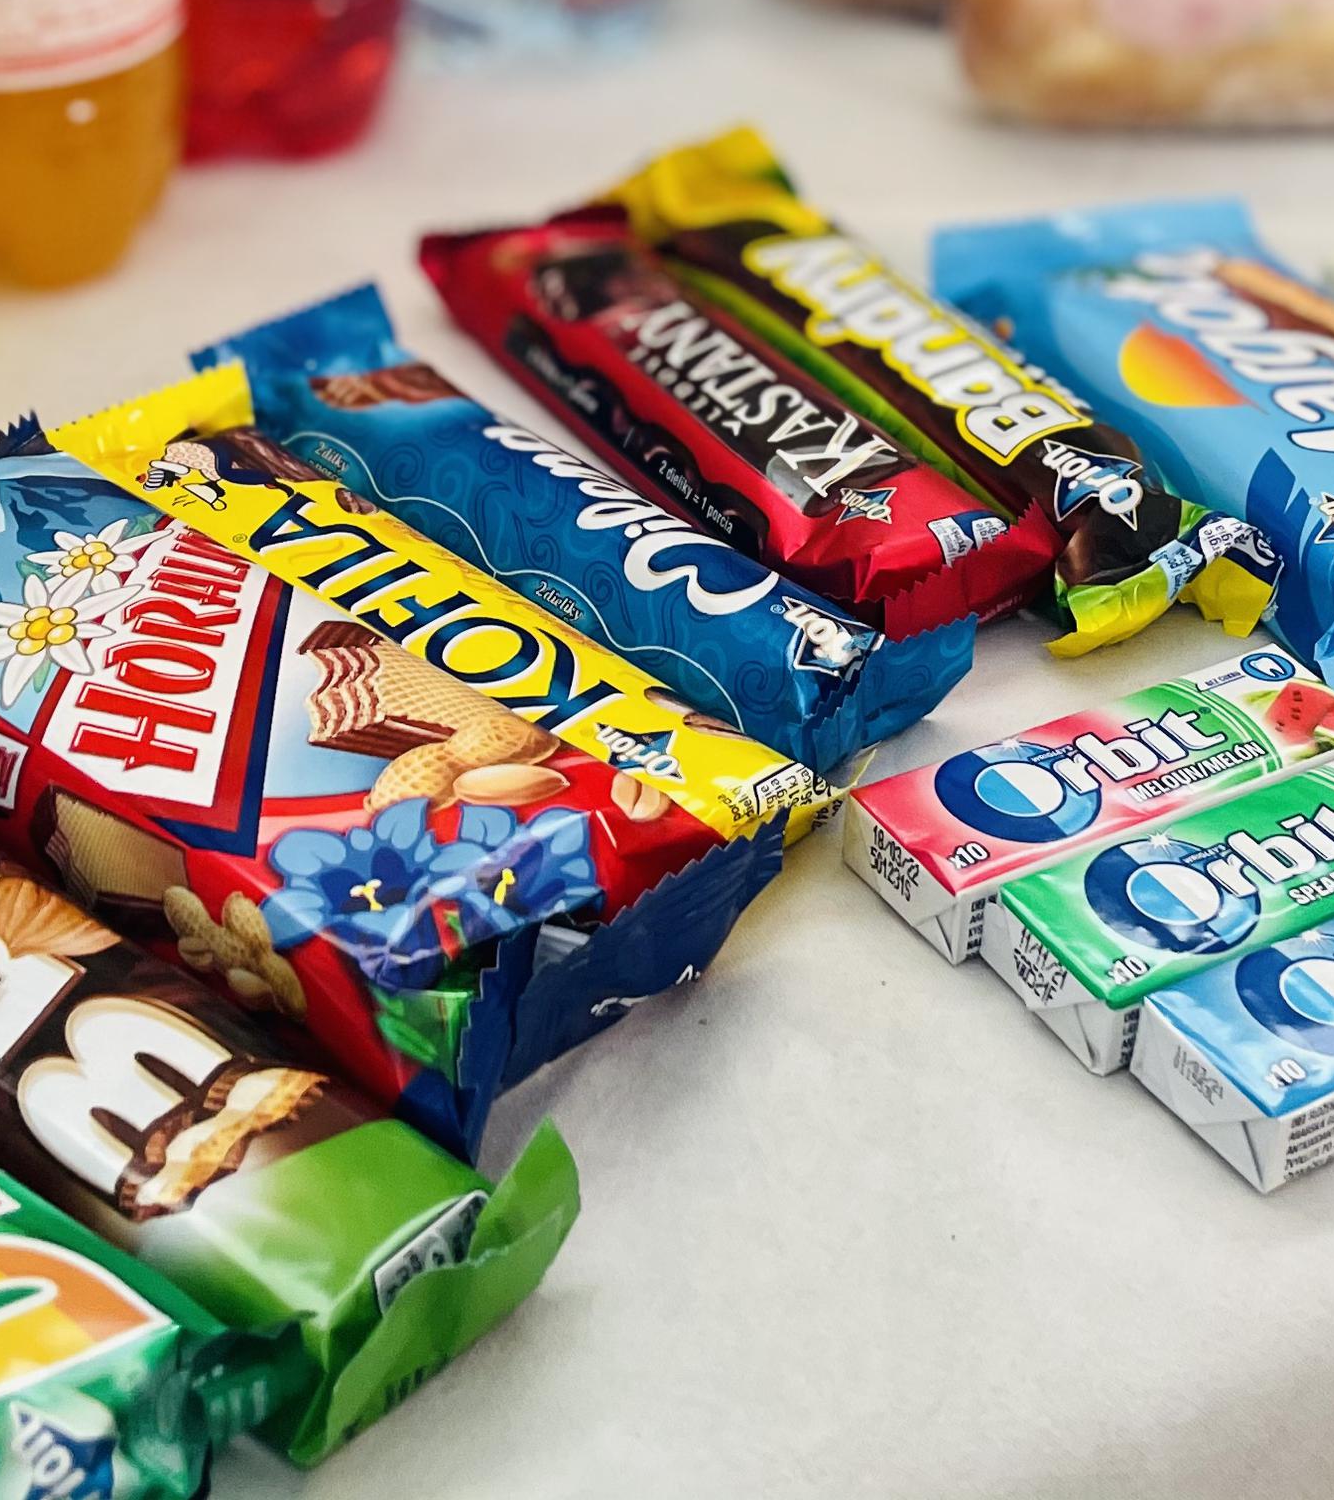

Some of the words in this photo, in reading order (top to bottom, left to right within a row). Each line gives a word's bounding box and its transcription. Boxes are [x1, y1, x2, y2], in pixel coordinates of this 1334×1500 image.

[840, 486, 893, 524] Orion
[1041, 439, 1145, 517] Orion
[250, 493, 625, 734] KOFILA
[69, 525, 250, 772] HORAL
[594, 722, 683, 779] Orion
[934, 706, 1229, 844] Orbit
[1126, 741, 1267, 804] MELOUN/MELÓN
[947, 840, 991, 870] x10
[1265, 1058, 1307, 1092] x10
